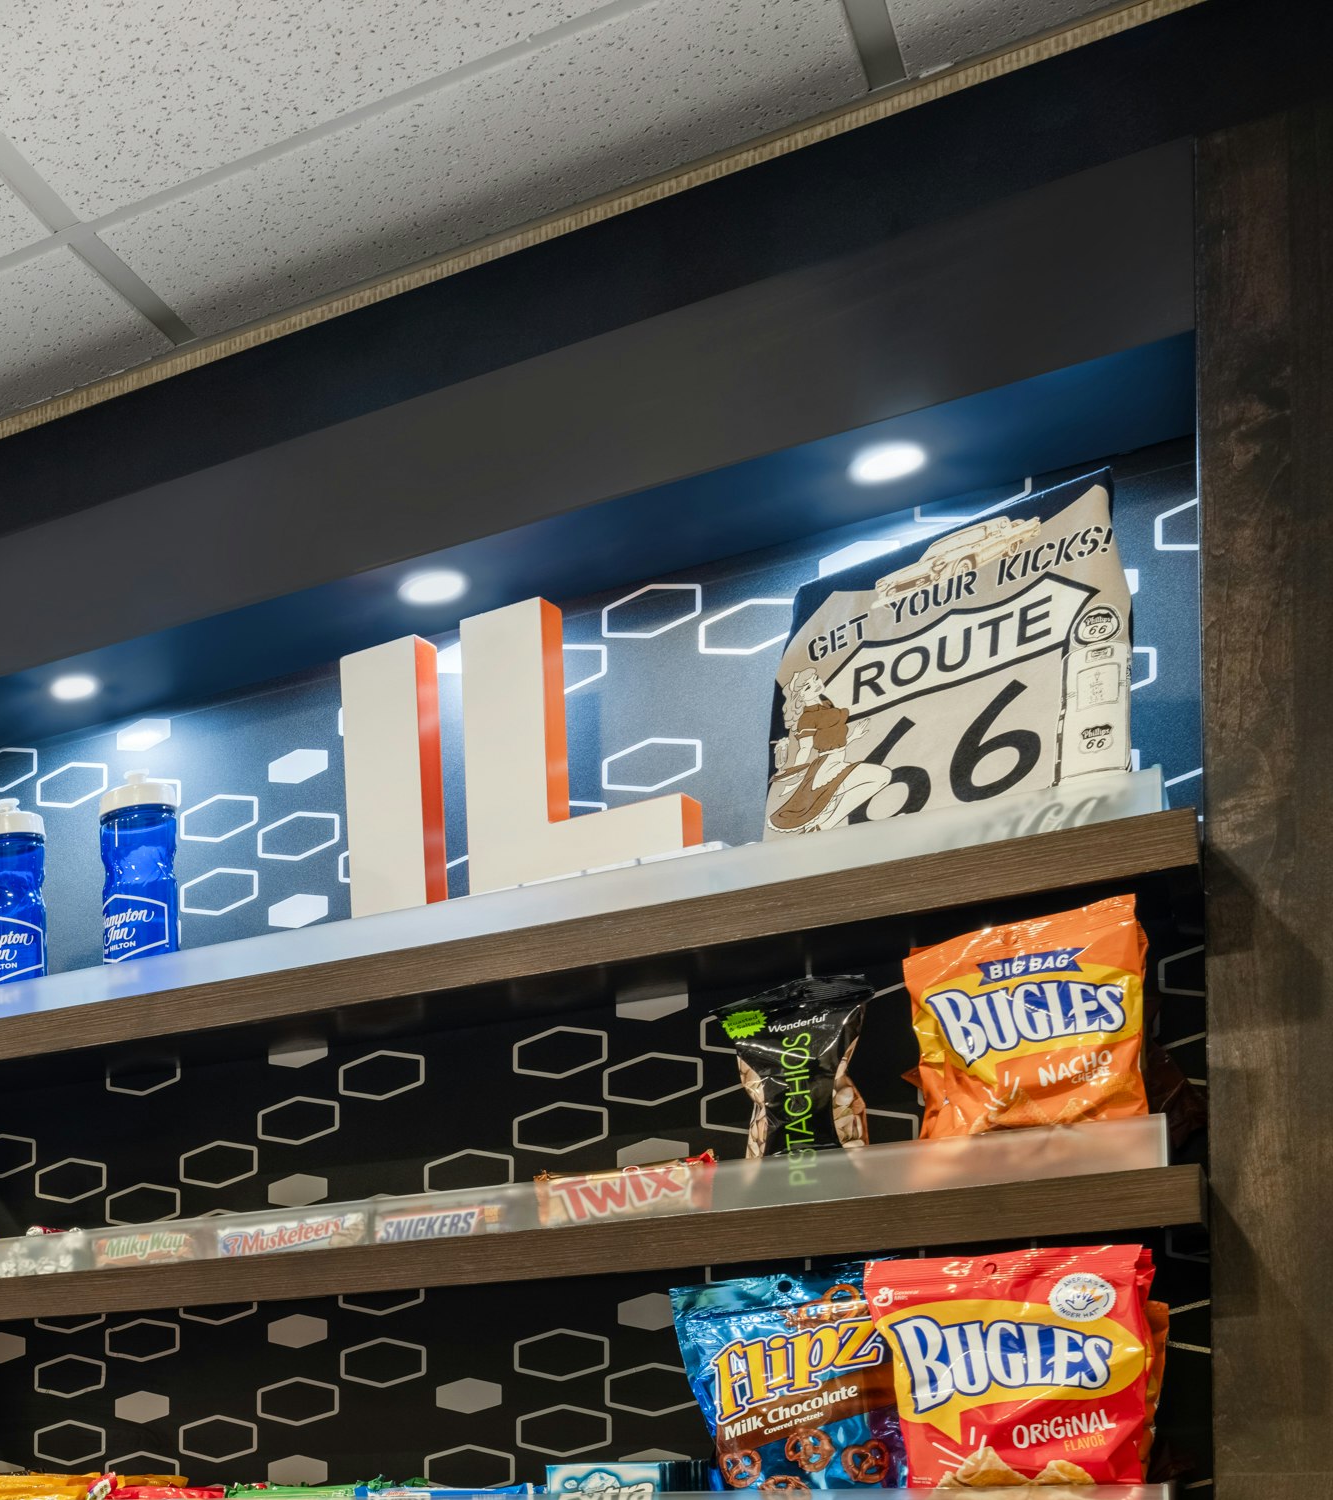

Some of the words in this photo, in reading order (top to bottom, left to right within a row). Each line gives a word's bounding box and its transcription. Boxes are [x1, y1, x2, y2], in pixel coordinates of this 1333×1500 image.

[807, 612, 868, 663] GET
[888, 569, 978, 625] YOUR
[997, 526, 1114, 586] KICKS!
[1084, 615, 1112, 626] Phillips
[1089, 624, 1107, 635] 66
[851, 594, 1053, 706] ROUTE
[1083, 726, 1112, 739] Phillips
[1086, 738, 1106, 749] 66
[844, 680, 1043, 825] 66
[106, 924, 135, 941] Inn
[110, 940, 136, 952] HILTON
[990, 958, 1024, 981] BIG
[1028, 952, 1072, 974] BAG
[727, 1014, 759, 1028] Roasted
[768, 1014, 826, 1034] Wonderful
[927, 980, 1126, 1068] BUGLES
[1038, 1050, 1113, 1087] NACHO
[1071, 1064, 1111, 1085] CHEESE
[780, 1032, 819, 1187] PISTACHIOS
[241, 1217, 343, 1256] Musketeers
[379, 1209, 481, 1242] SNICKERS
[107, 1235, 148, 1259] Milky
[149, 1232, 185, 1254] Way
[1057, 1303, 1081, 1318] FINGER
[711, 1316, 880, 1424] Flipz
[892, 1315, 1113, 1414] BUGLES
[724, 1412, 764, 1441] Milk
[767, 1382, 859, 1426] Chocolate
[763, 1420, 792, 1436] Covered
[793, 1410, 824, 1427] Pretzels
[1063, 1434, 1106, 1453] FLAVOR
